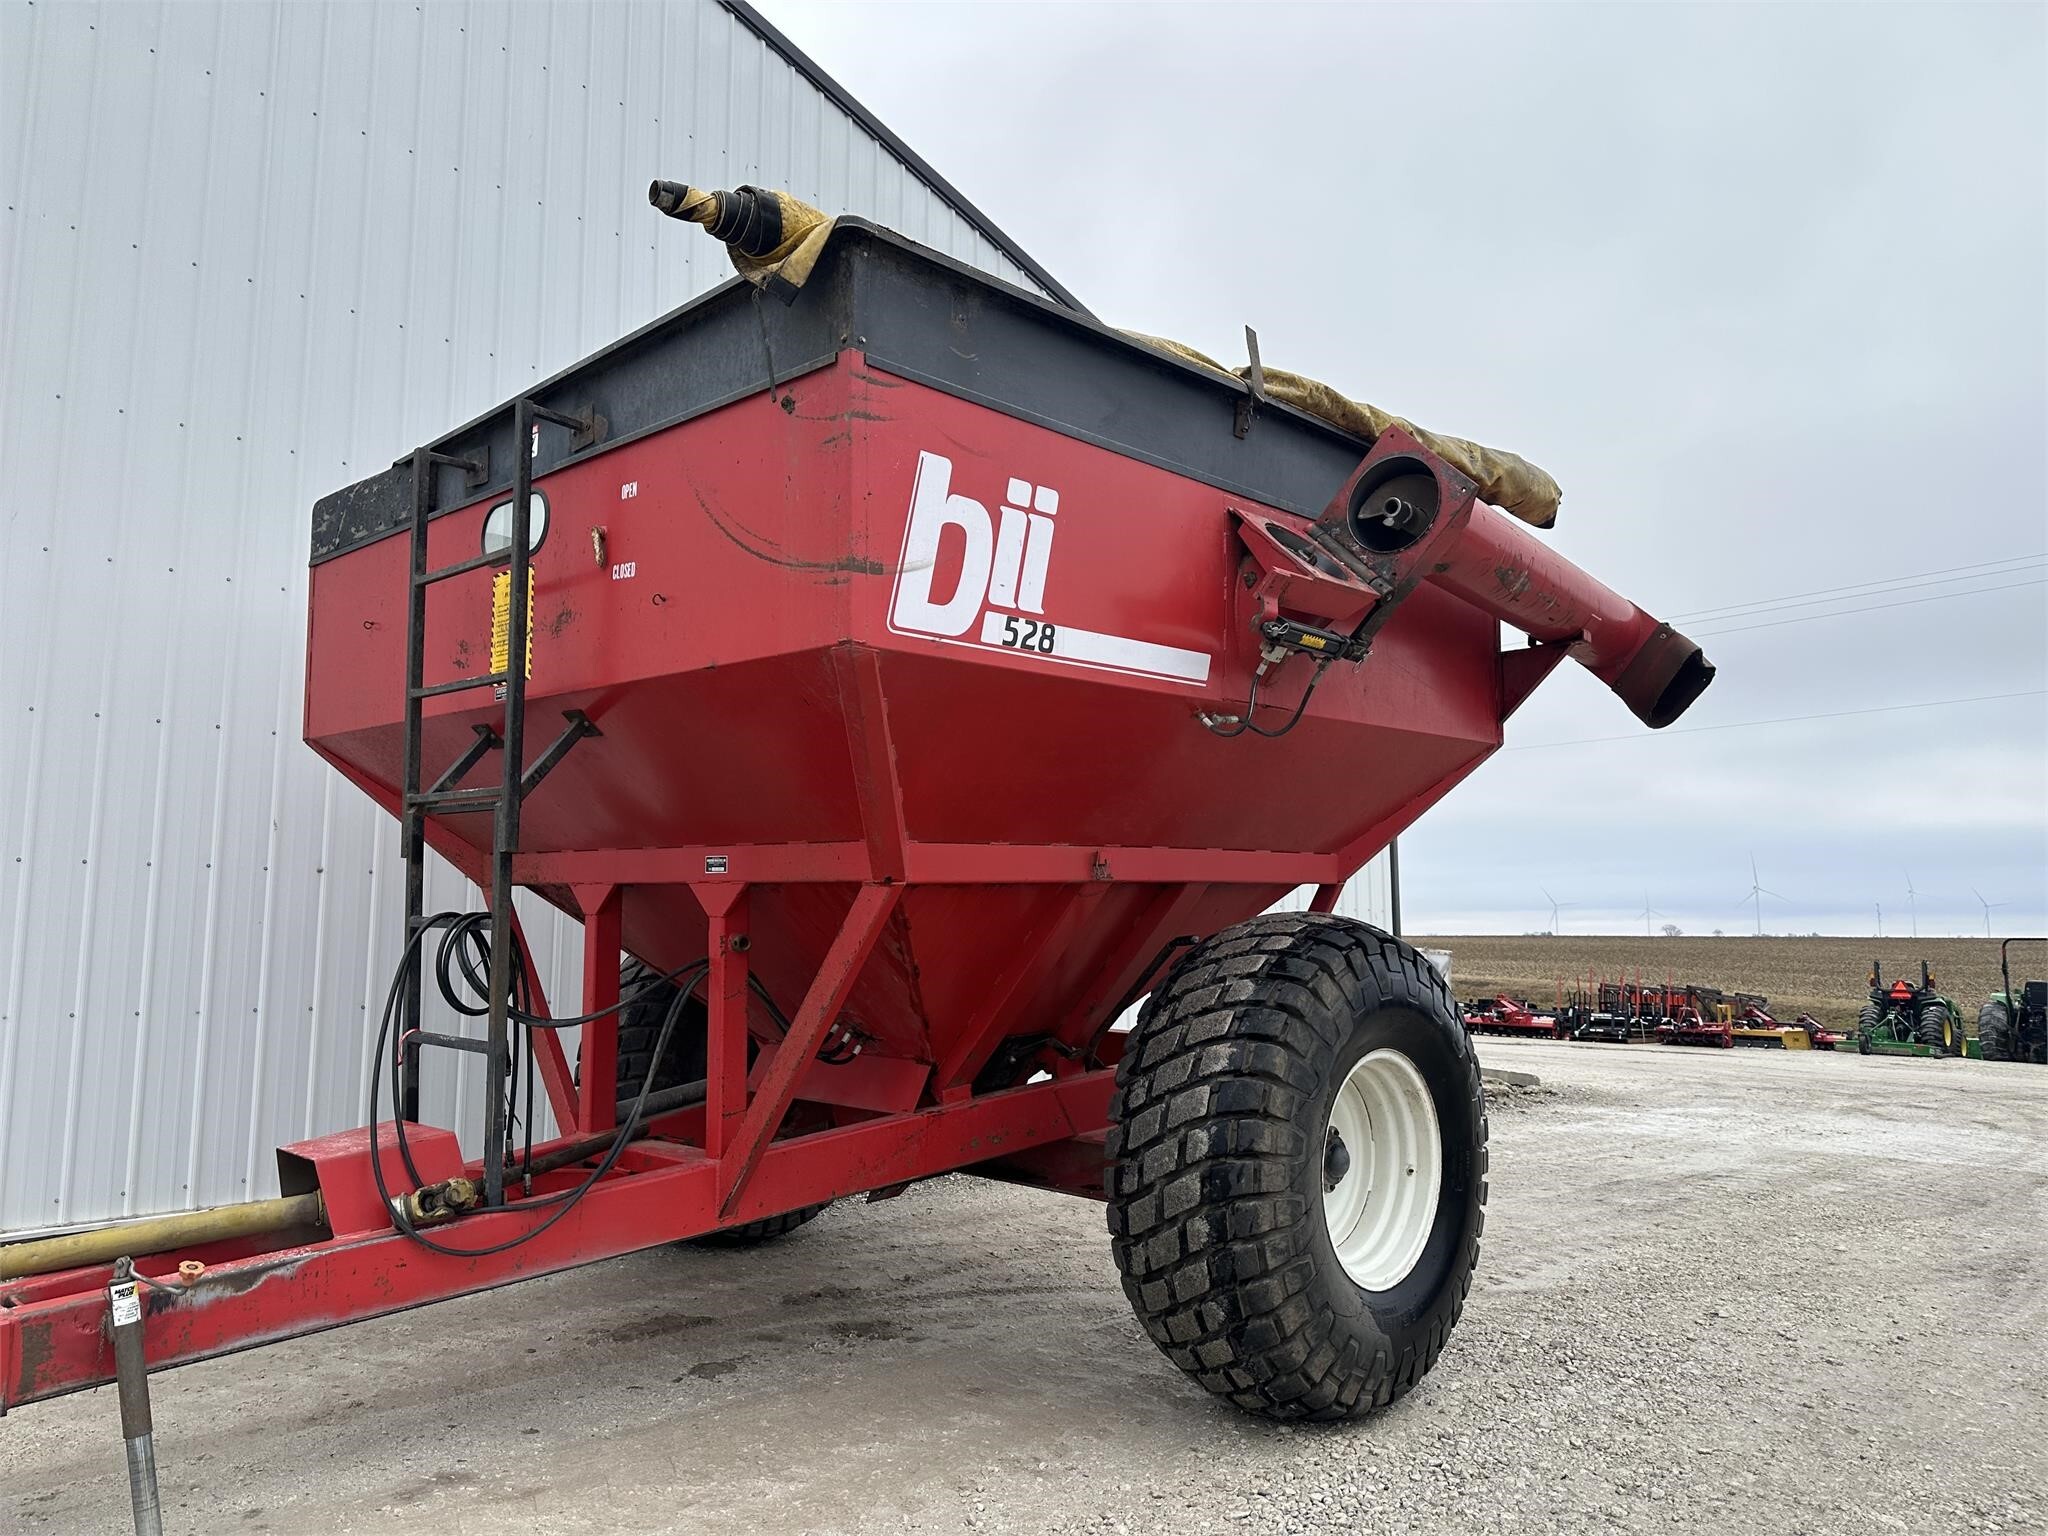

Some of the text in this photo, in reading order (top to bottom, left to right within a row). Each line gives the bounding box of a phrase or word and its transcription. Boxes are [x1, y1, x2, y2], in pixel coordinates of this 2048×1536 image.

[621, 481, 638, 500] OPEN
[612, 562, 636, 580] CLOSED
[1002, 616, 1056, 653] 528
